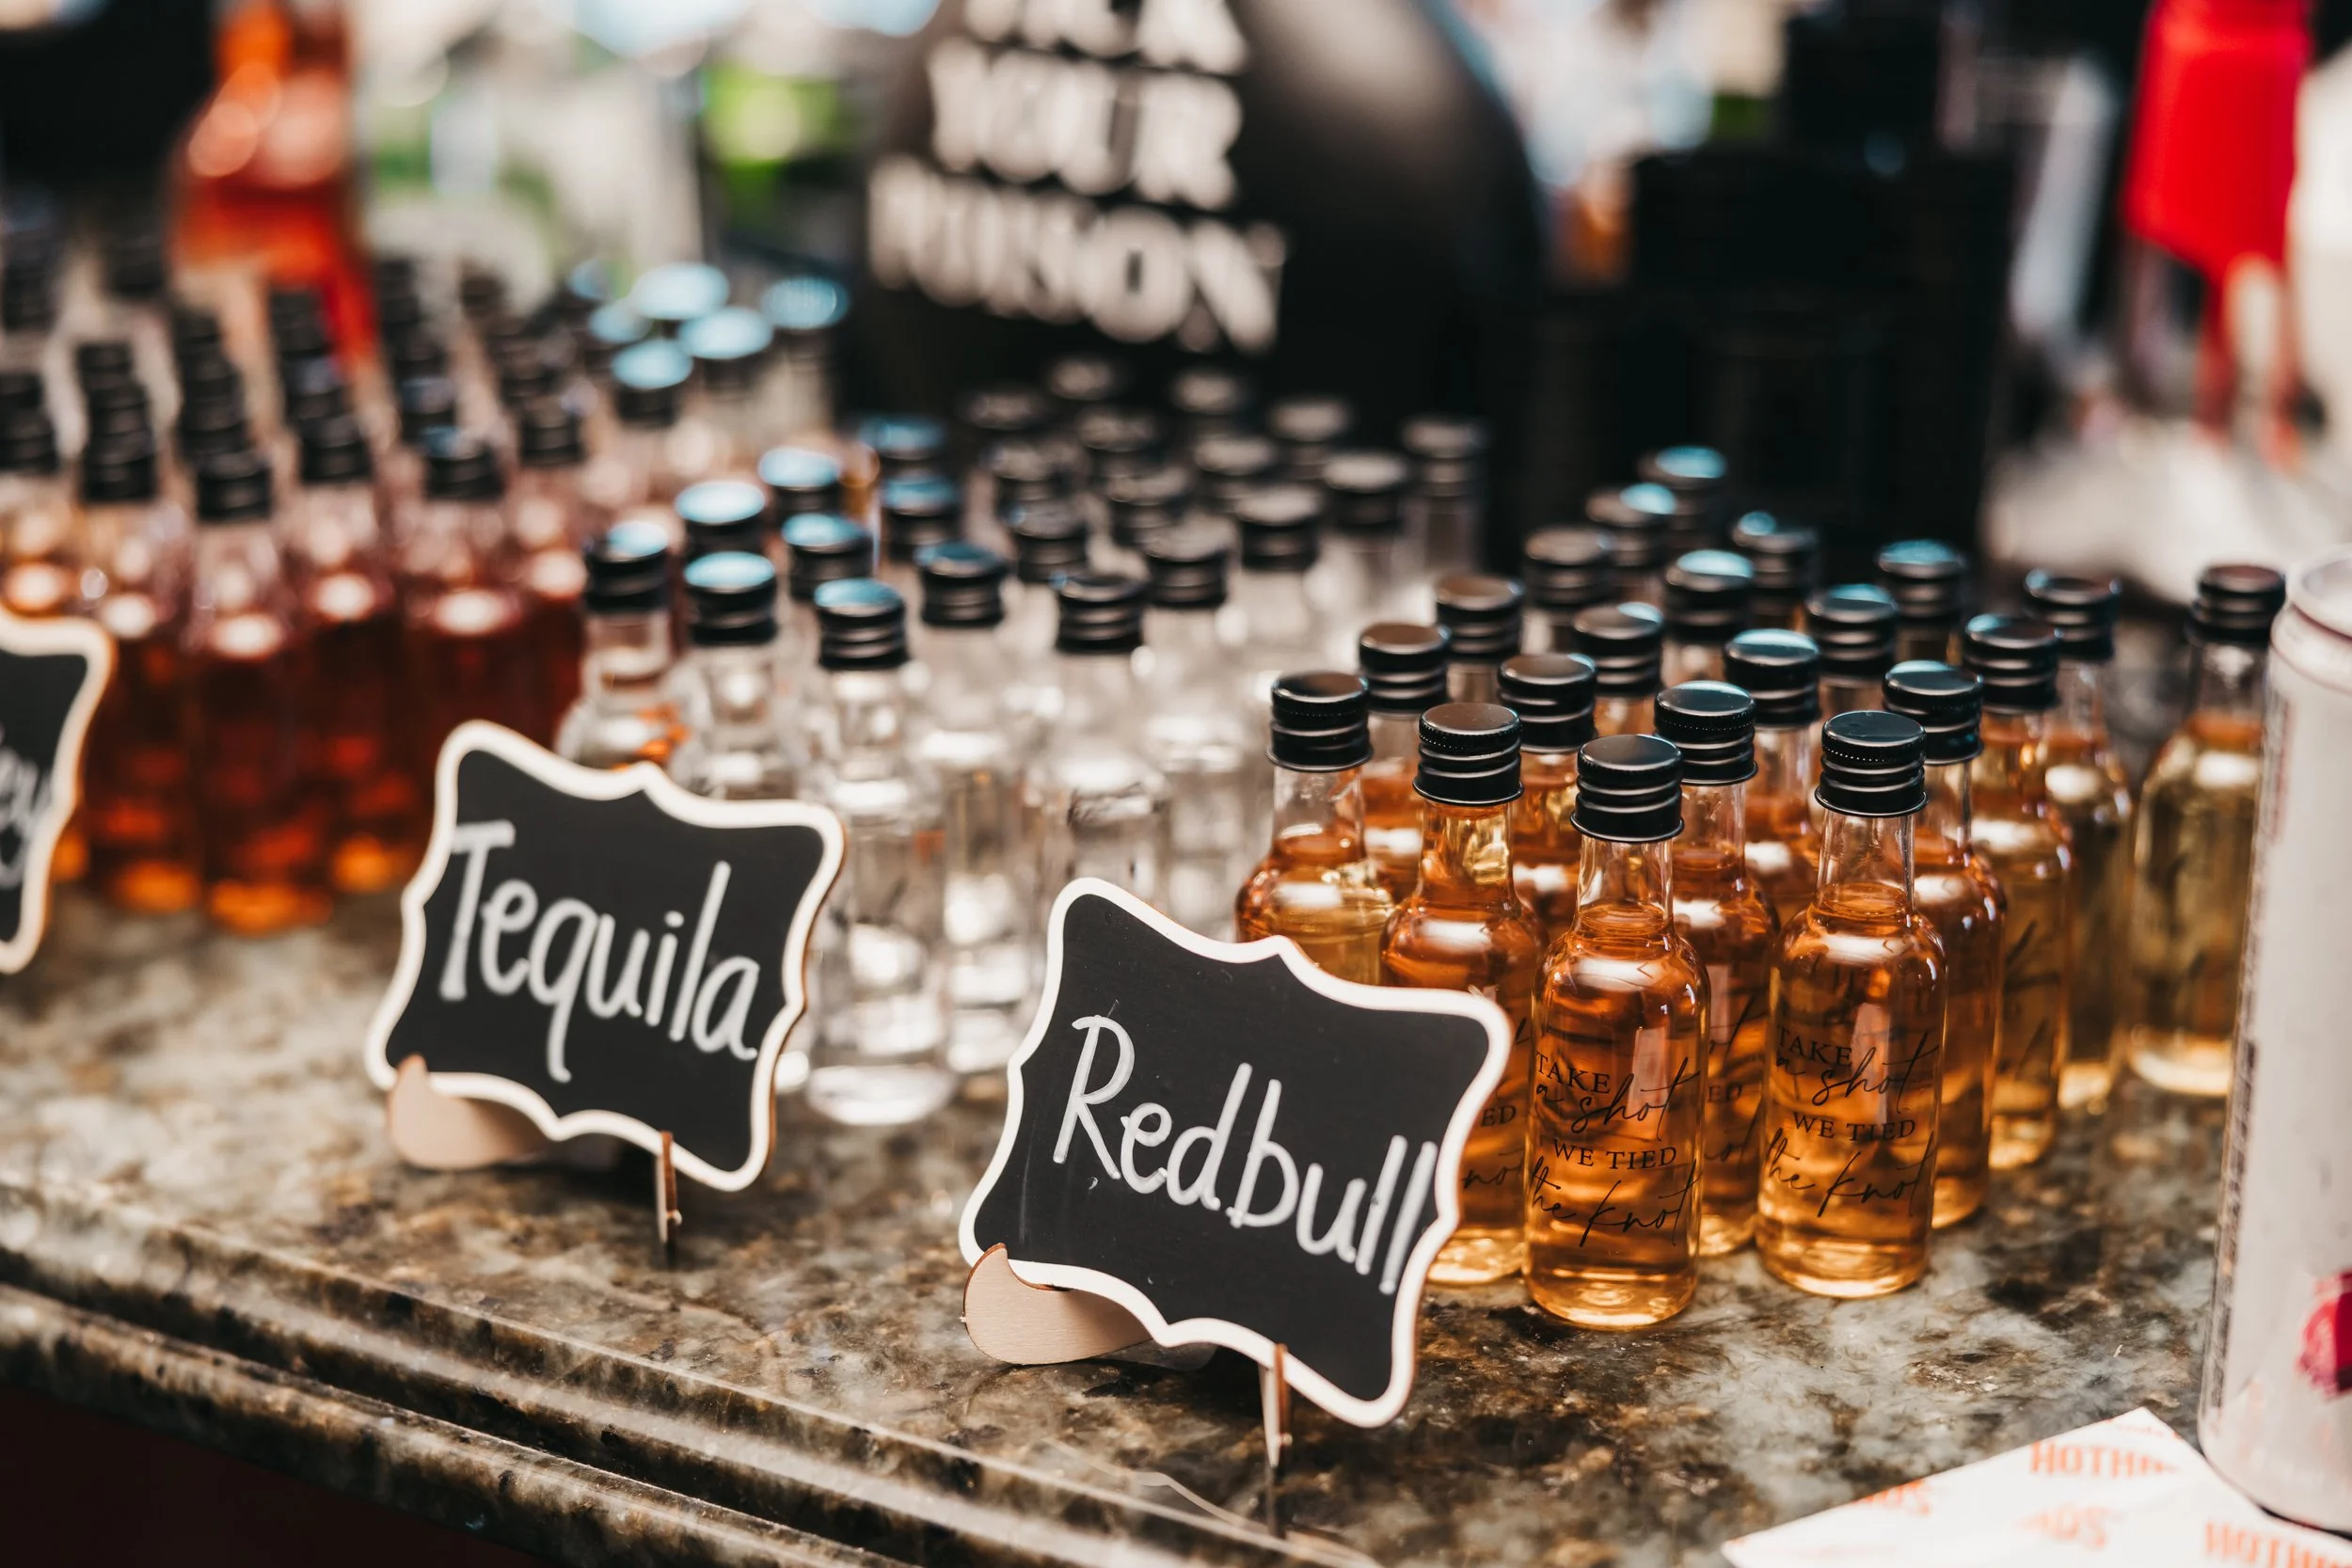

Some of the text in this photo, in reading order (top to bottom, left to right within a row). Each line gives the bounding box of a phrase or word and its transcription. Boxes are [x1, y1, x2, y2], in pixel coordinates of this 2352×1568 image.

[439, 819, 760, 1083] Tequila
[1535, 1051, 1611, 1094] TAKE
[1777, 1024, 1852, 1068] TAKE
[1812, 1031, 1939, 1114] shot
[1570, 1056, 1701, 1141] shot
[1793, 1111, 1915, 1142] WE TIED
[1052, 1014, 1438, 1296] Redbull
[1553, 1138, 1677, 1170] WE TIED
[1817, 1131, 1936, 1217] knot
[1579, 1159, 1702, 1247] knot
